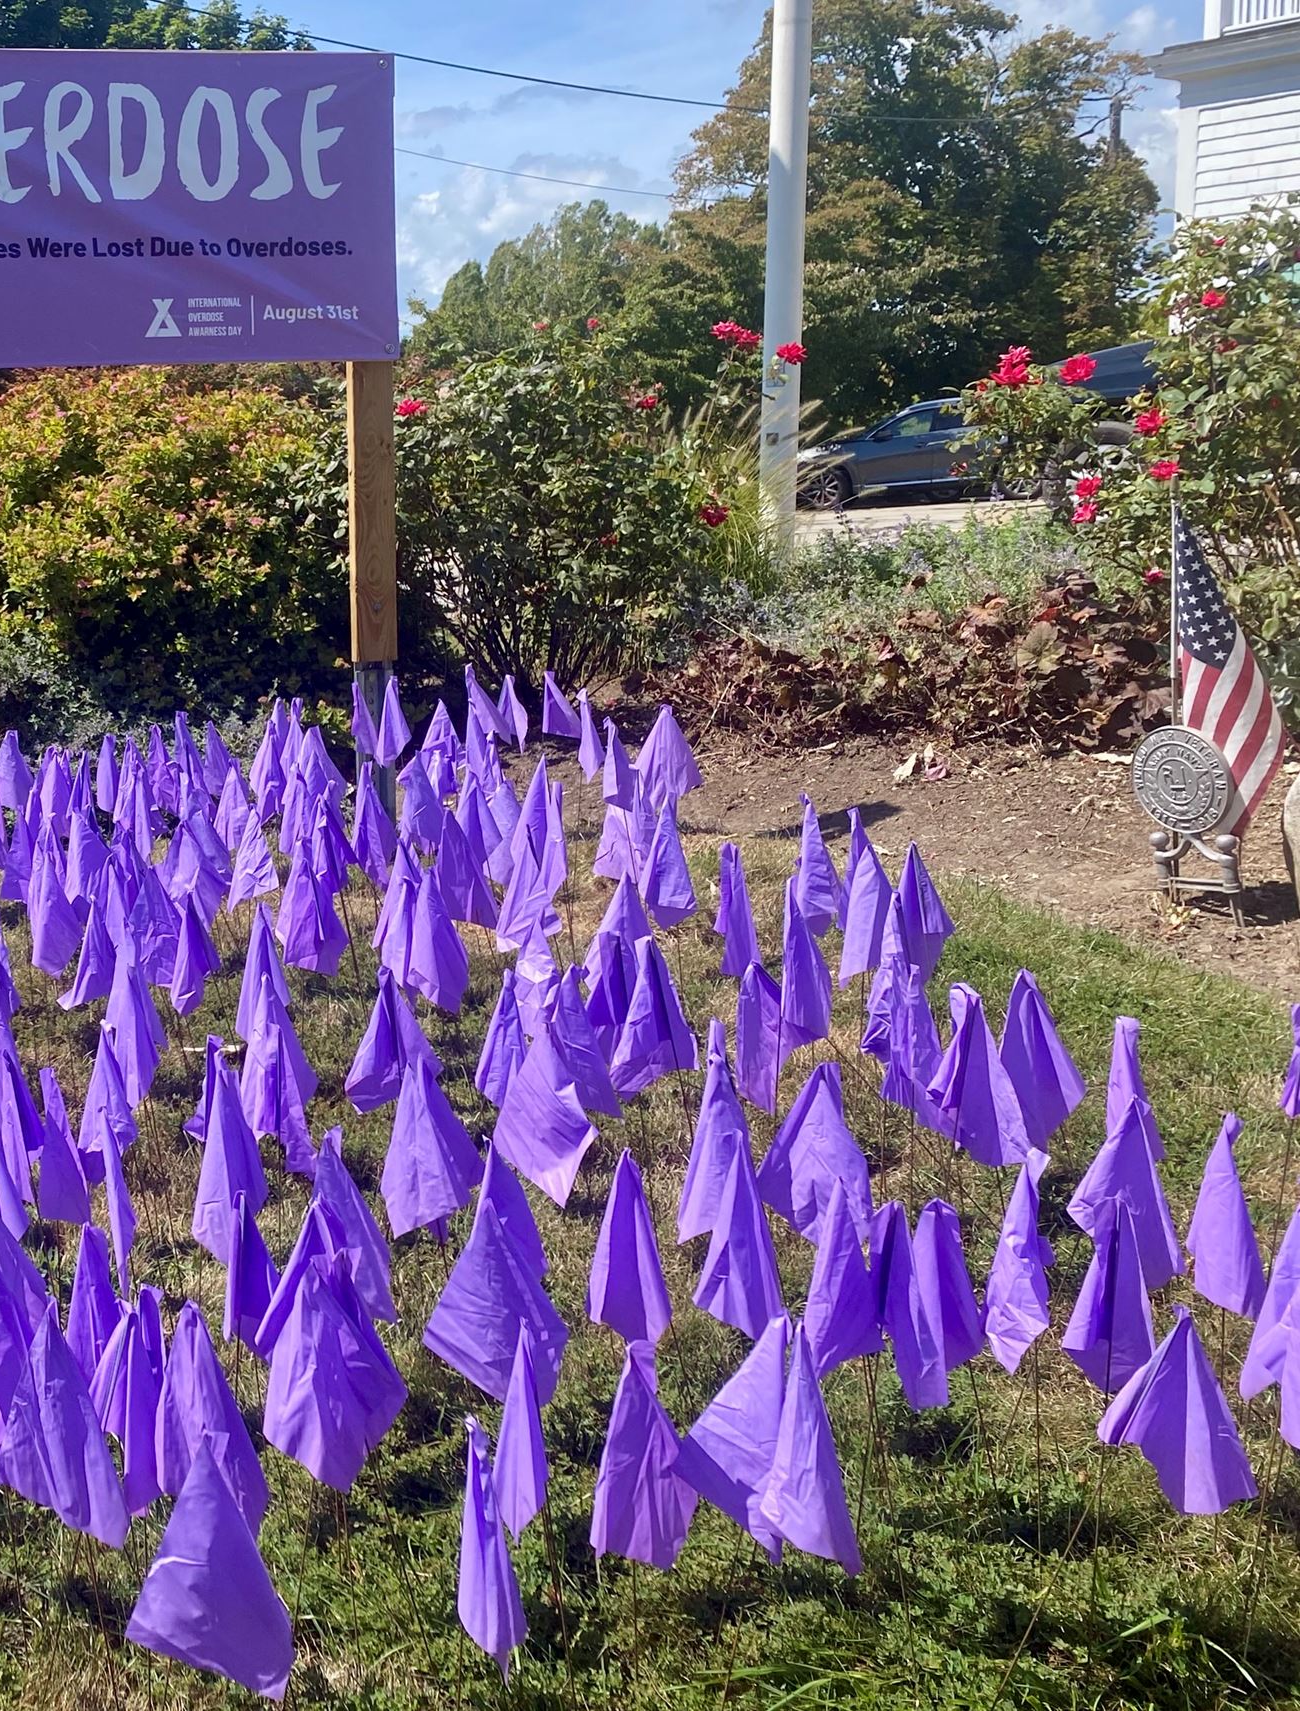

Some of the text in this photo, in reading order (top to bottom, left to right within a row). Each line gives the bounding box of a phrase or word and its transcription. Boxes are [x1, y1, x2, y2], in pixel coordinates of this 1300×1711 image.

[26, 237, 87, 258] Were
[92, 237, 144, 258] Lost
[150, 236, 194, 257] Due
[199, 238, 222, 256] to
[226, 236, 353, 258] Overdoses.
[187, 297, 242, 308] INTERNATIONAL
[188, 312, 224, 323] OVERDOSE
[262, 304, 359, 324] August 31st
[188, 326, 242, 337] AWARNESS DAY
[1134, 730, 1227, 791] WORLD WAR VETERAN
[1177, 747, 1203, 770] NAVY
